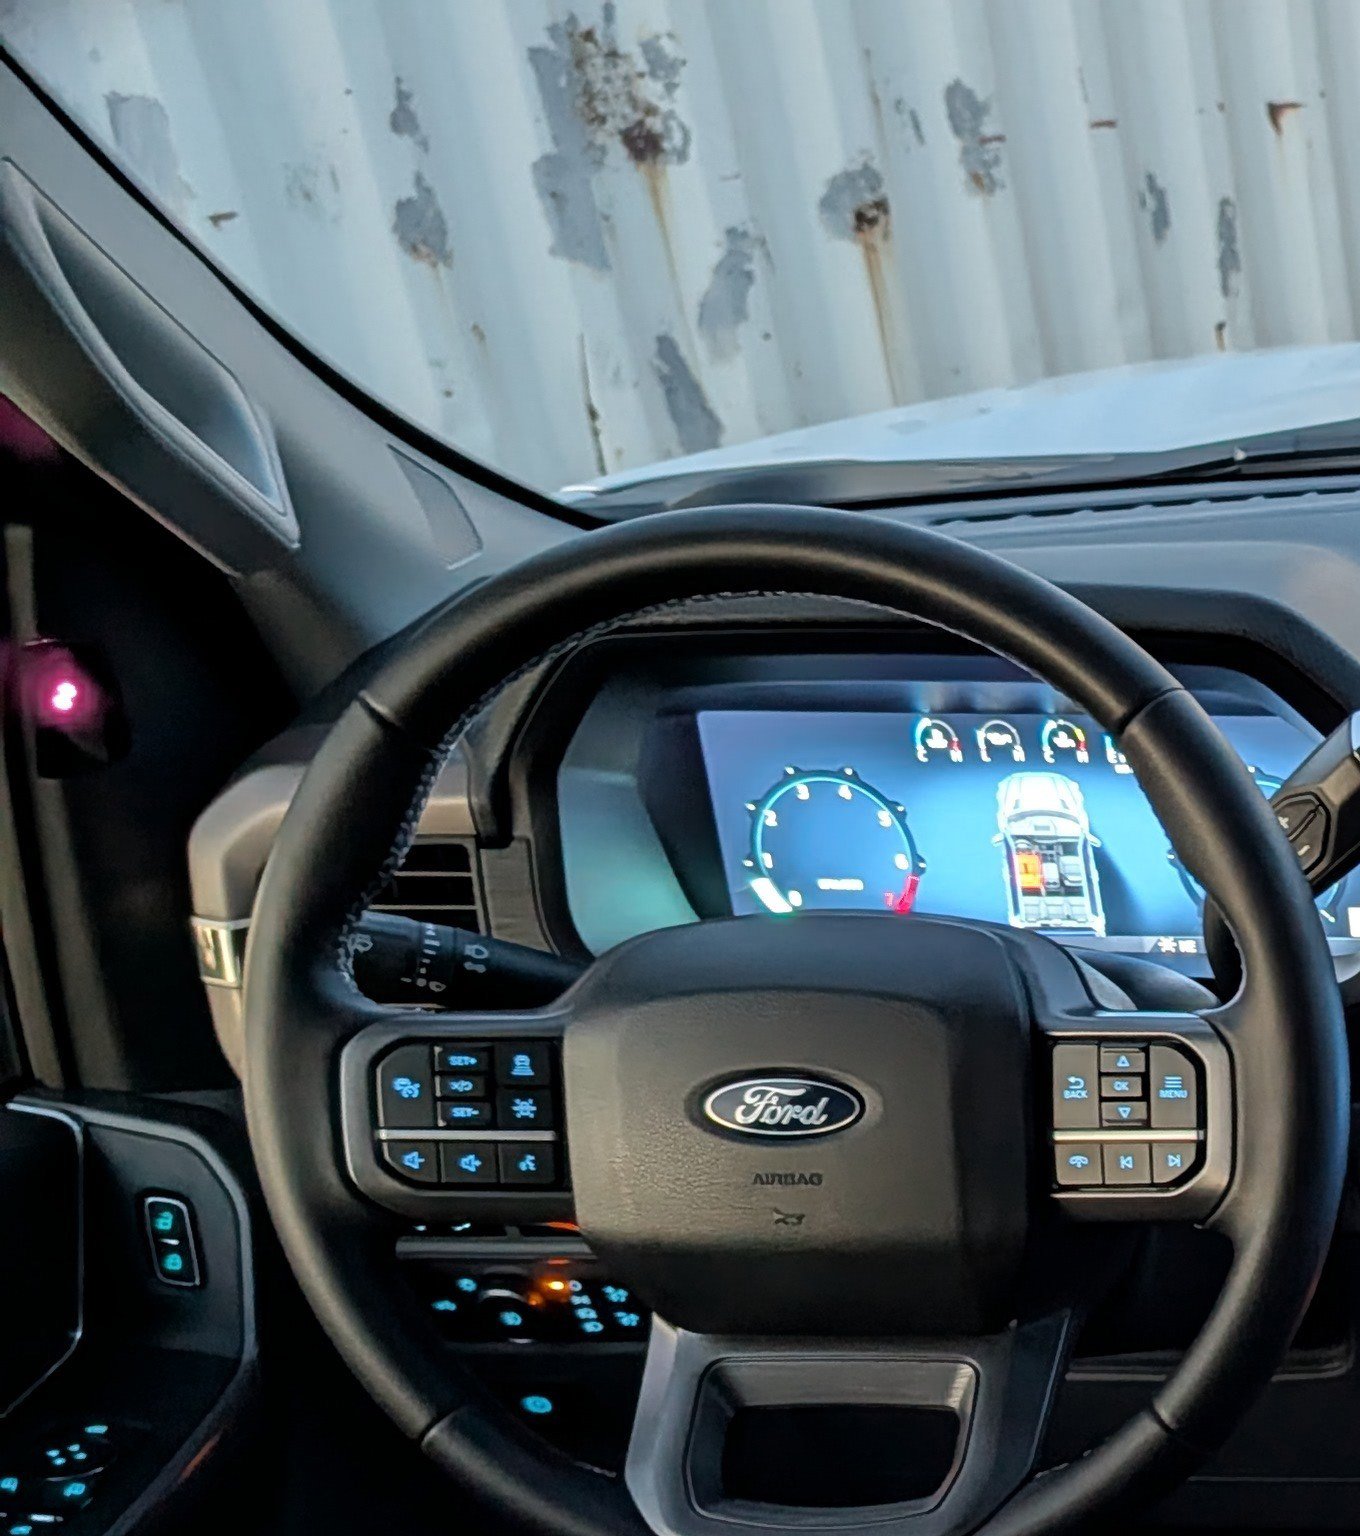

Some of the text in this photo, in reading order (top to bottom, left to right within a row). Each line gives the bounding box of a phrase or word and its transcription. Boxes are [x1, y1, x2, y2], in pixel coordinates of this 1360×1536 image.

[1062, 1089, 1089, 1100] BACK
[734, 1086, 831, 1125] Ford
[752, 1172, 824, 1187] AIRBAG
